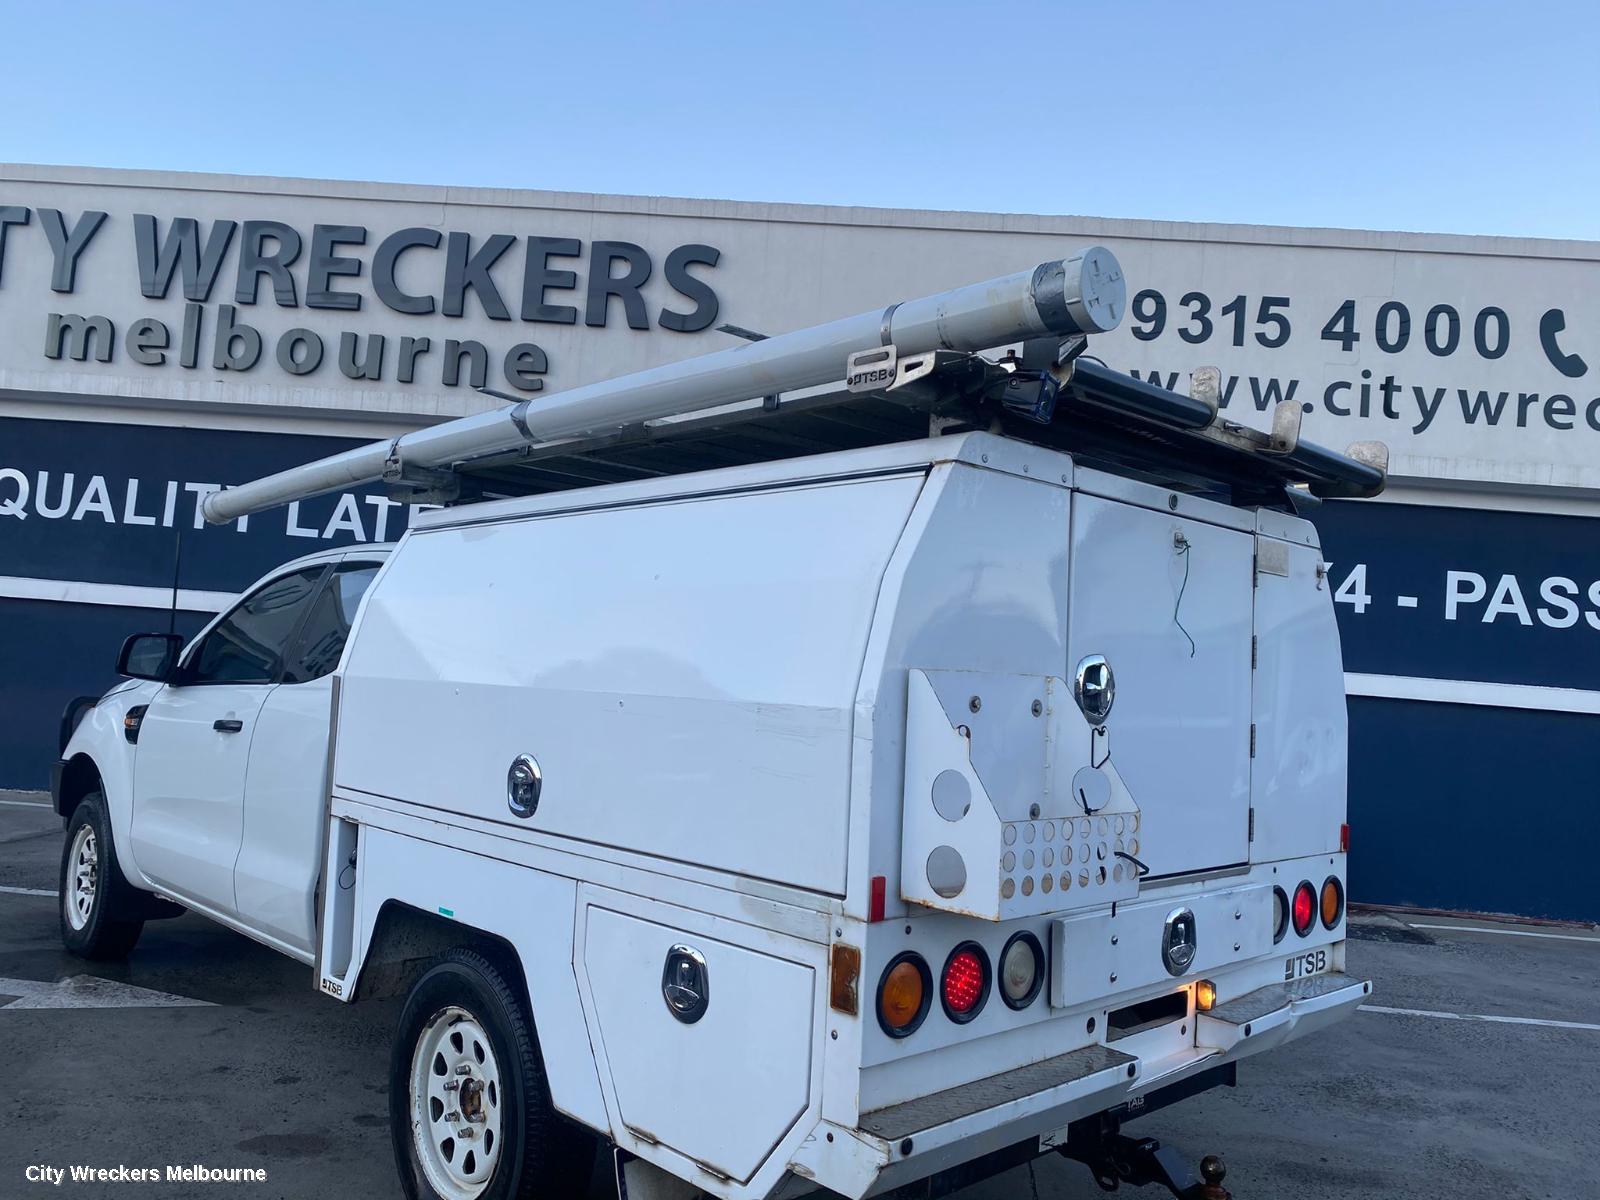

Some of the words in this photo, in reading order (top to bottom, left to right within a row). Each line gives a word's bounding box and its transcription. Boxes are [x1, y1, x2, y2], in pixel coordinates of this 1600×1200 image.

[133, 213, 721, 333] WRECKERS
[44, 303, 549, 391] melbourne
[1131, 289, 1291, 348] 9315
[1320, 299, 1510, 360] 4000
[1324, 561, 1371, 614] 4
